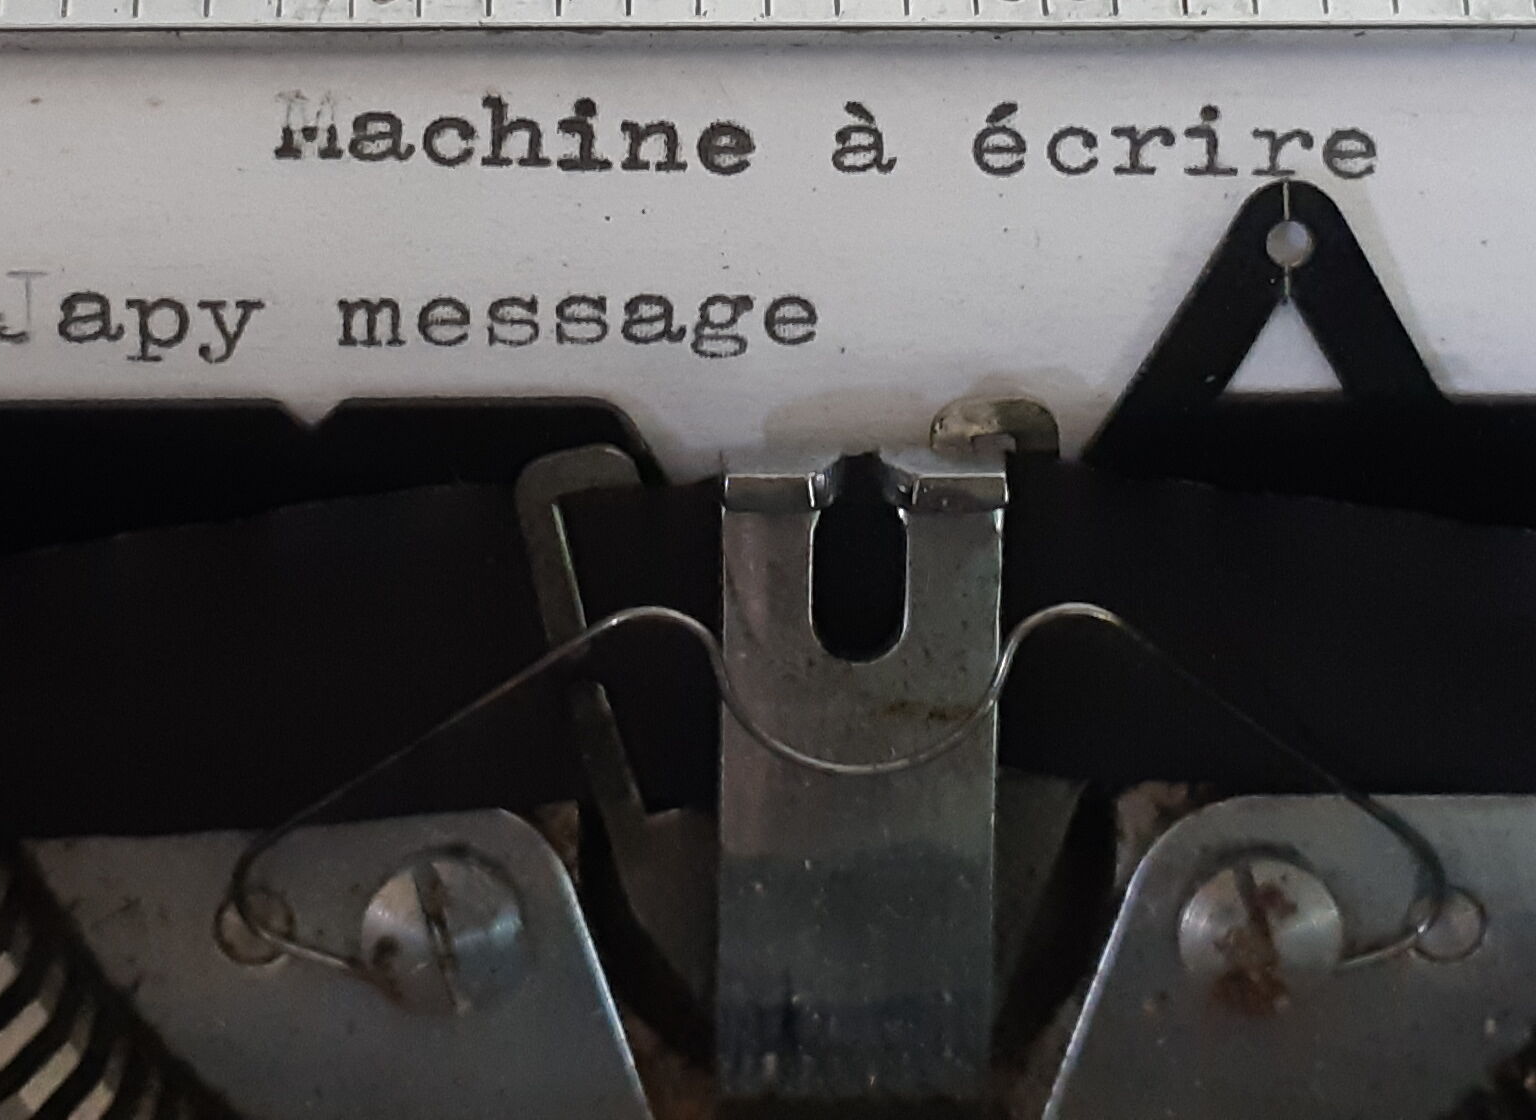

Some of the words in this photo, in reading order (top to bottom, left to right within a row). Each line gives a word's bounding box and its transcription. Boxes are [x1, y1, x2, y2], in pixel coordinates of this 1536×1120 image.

[273, 90, 755, 174] Machine
[832, 100, 898, 176] à
[973, 100, 1379, 180] écrire
[336, 290, 819, 360] message
